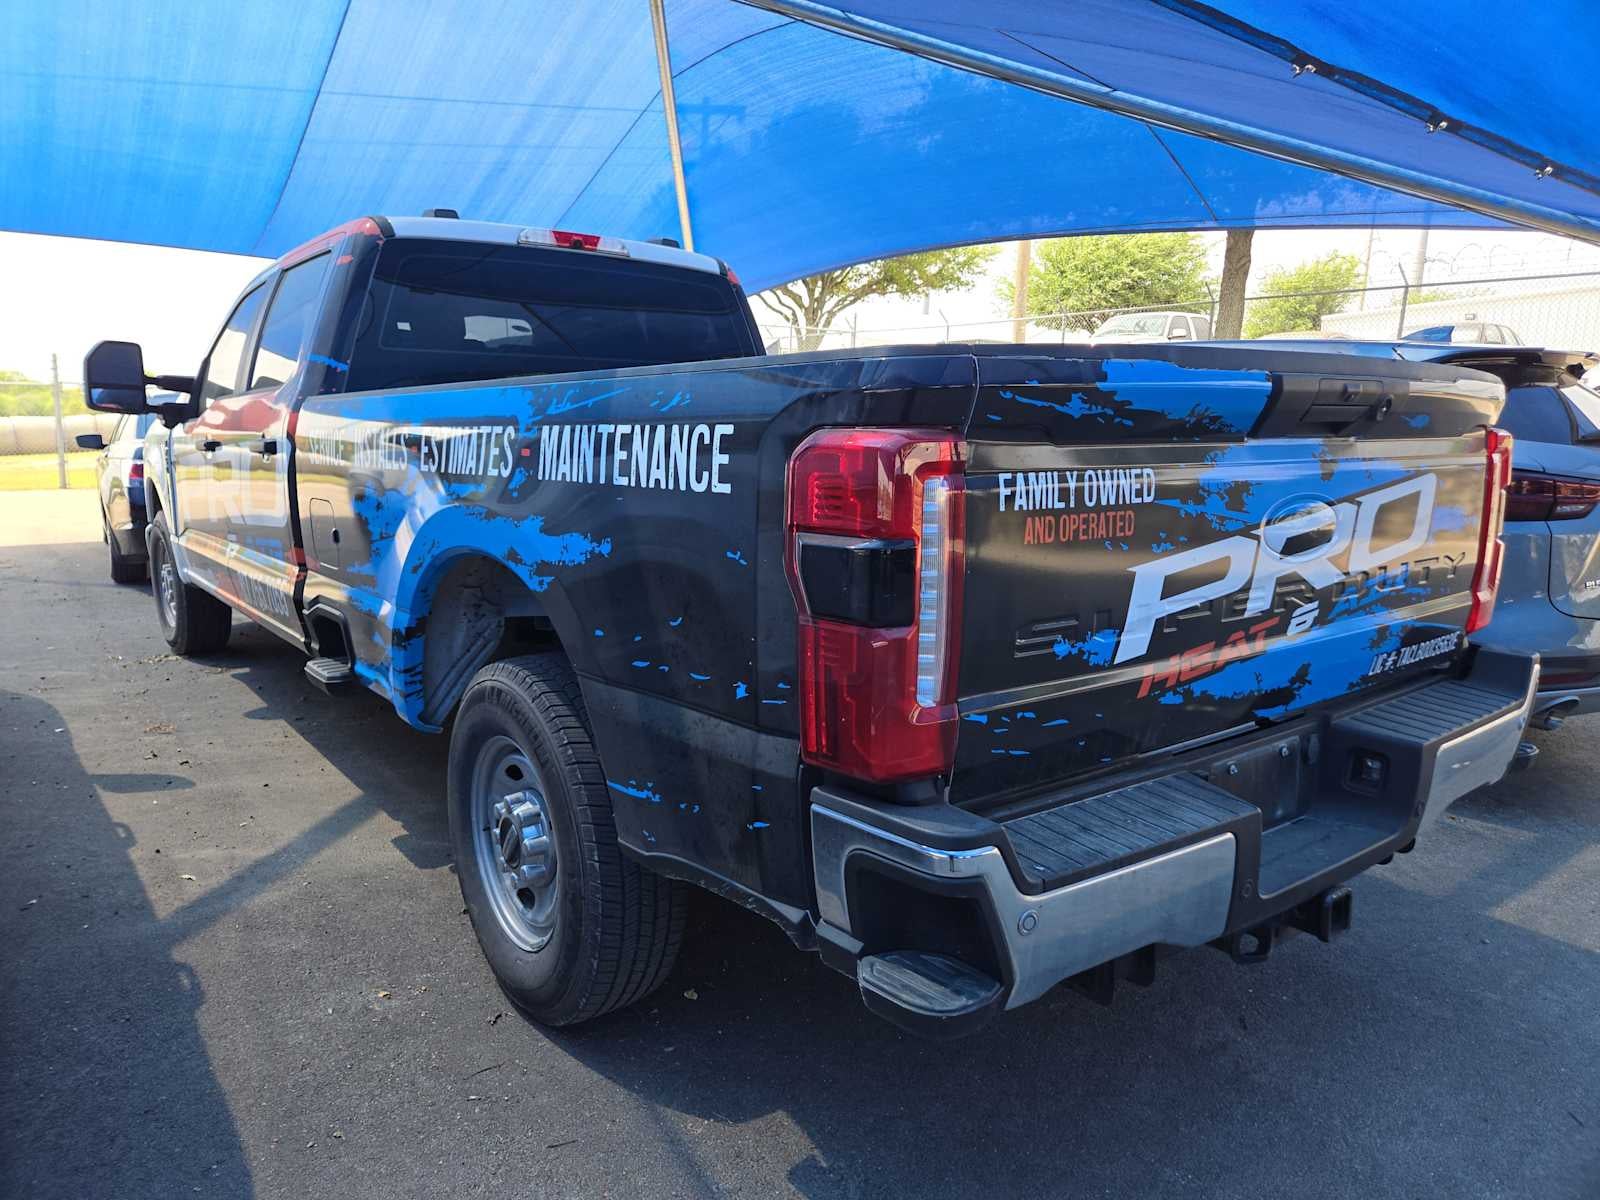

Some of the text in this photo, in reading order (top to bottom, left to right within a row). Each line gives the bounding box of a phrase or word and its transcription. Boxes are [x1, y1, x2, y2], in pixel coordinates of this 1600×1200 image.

[354, 427, 410, 471] INSTALLS
[420, 426, 515, 479] ESTIMATES
[537, 423, 735, 494] MAINTENANCE
[998, 468, 1155, 511] FAMILY OWNED
[1023, 510, 1135, 545] AND OPERATED
[1114, 473, 1438, 665] PRO
[1332, 551, 1466, 602] DUTY
[1136, 616, 1280, 699] HEAT
